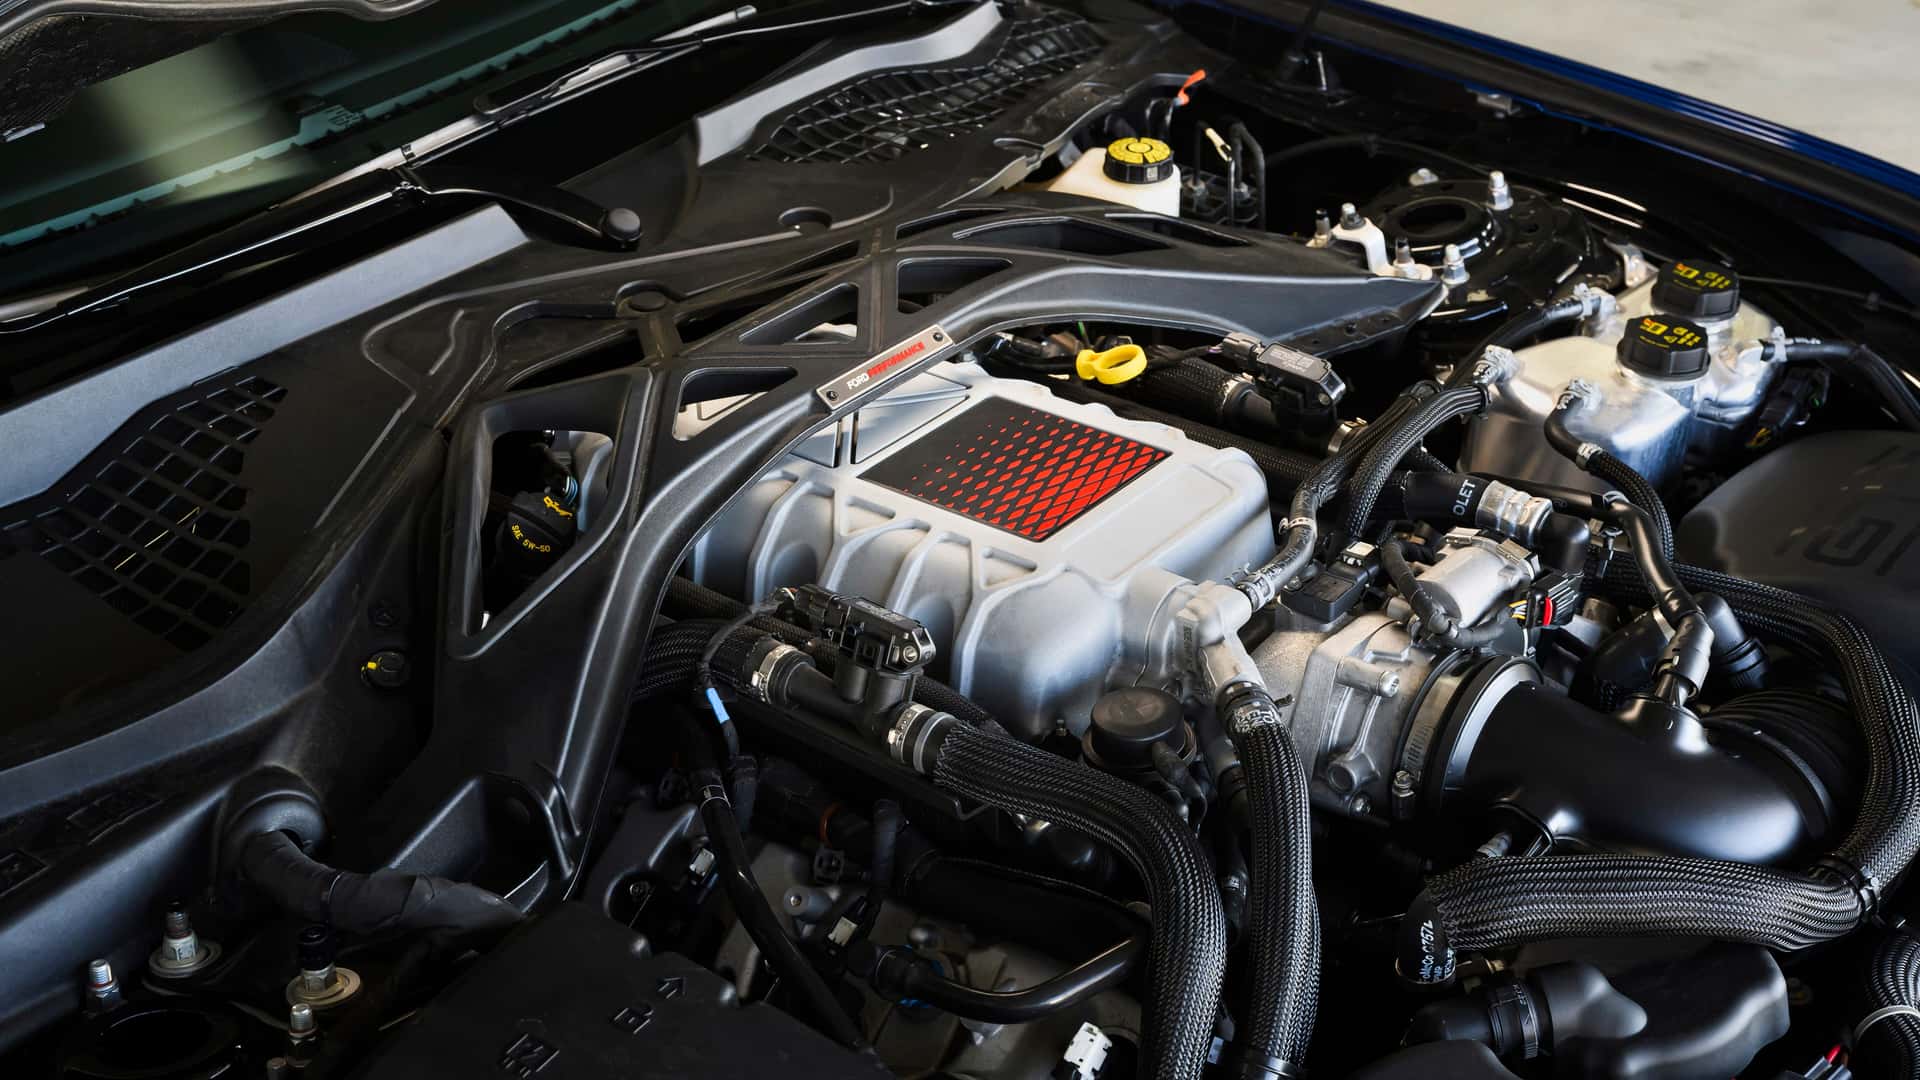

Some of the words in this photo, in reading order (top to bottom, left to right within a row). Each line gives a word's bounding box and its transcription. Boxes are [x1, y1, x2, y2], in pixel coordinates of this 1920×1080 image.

[847, 372, 870, 390] FORD
[867, 341, 926, 378] PERFORMANCE
[522, 538, 551, 553] 5W-50
